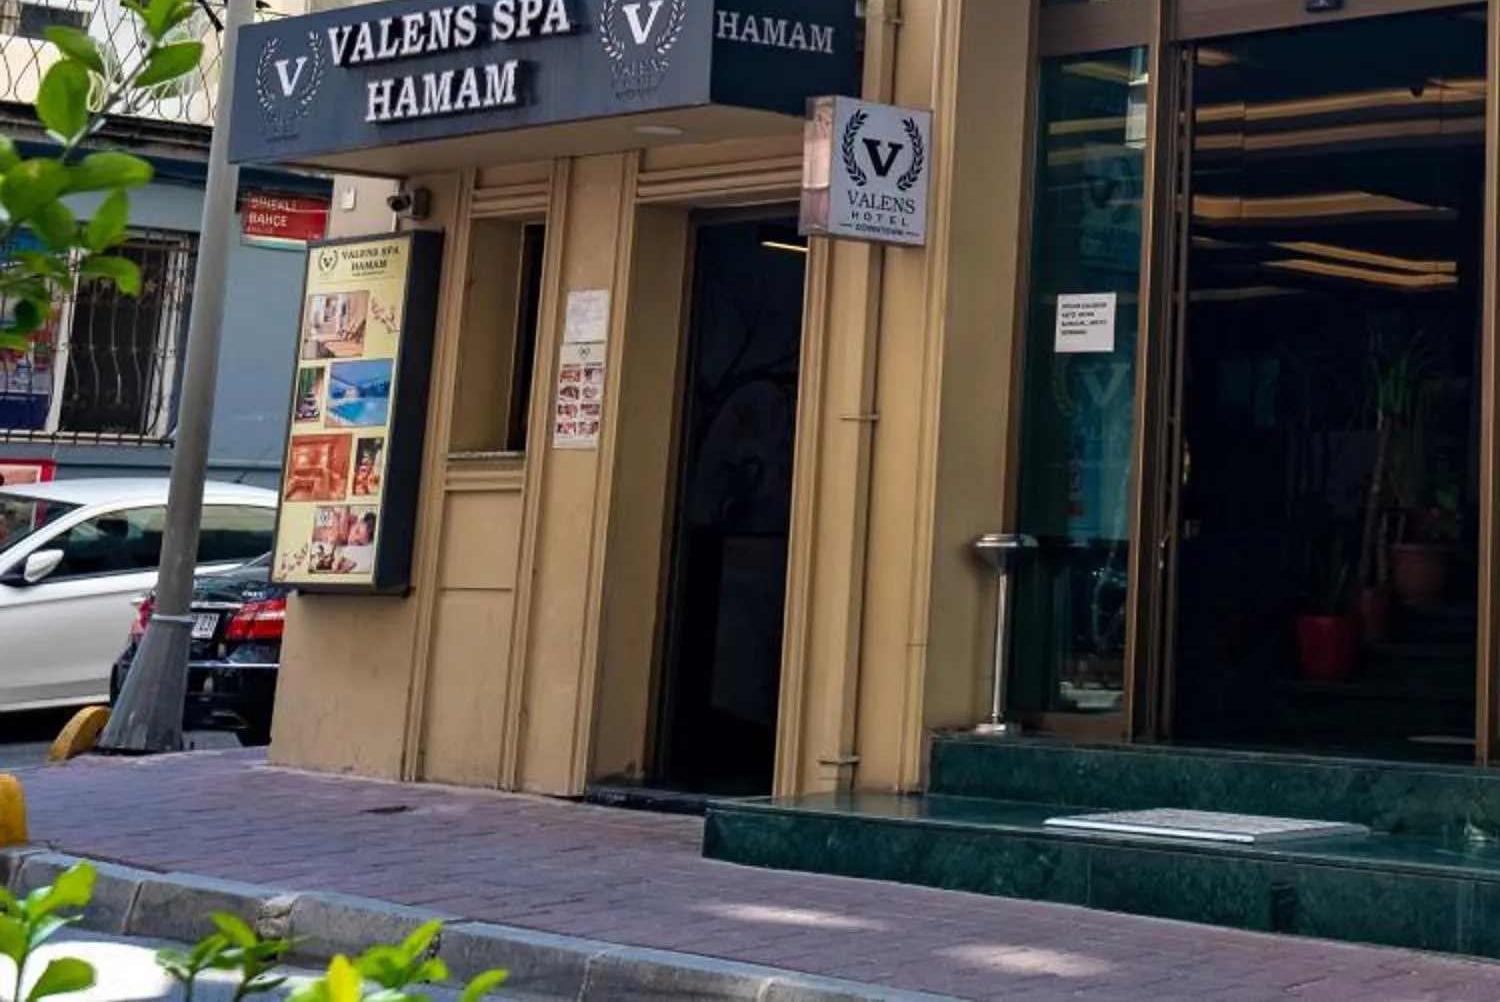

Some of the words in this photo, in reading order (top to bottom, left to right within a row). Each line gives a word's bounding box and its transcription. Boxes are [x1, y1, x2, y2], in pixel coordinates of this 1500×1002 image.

[326, 2, 479, 67] VALENS
[622, 0, 665, 45] V
[716, 10, 835, 56] HAMAM
[273, 56, 309, 97] V
[364, 60, 519, 123] HAMAM
[862, 138, 903, 177] V
[848, 190, 915, 214] VALENS
[852, 211, 909, 227] HOTEL
[856, 223, 903, 236] DOWNTOWN
[351, 259, 387, 271] HAMAM
